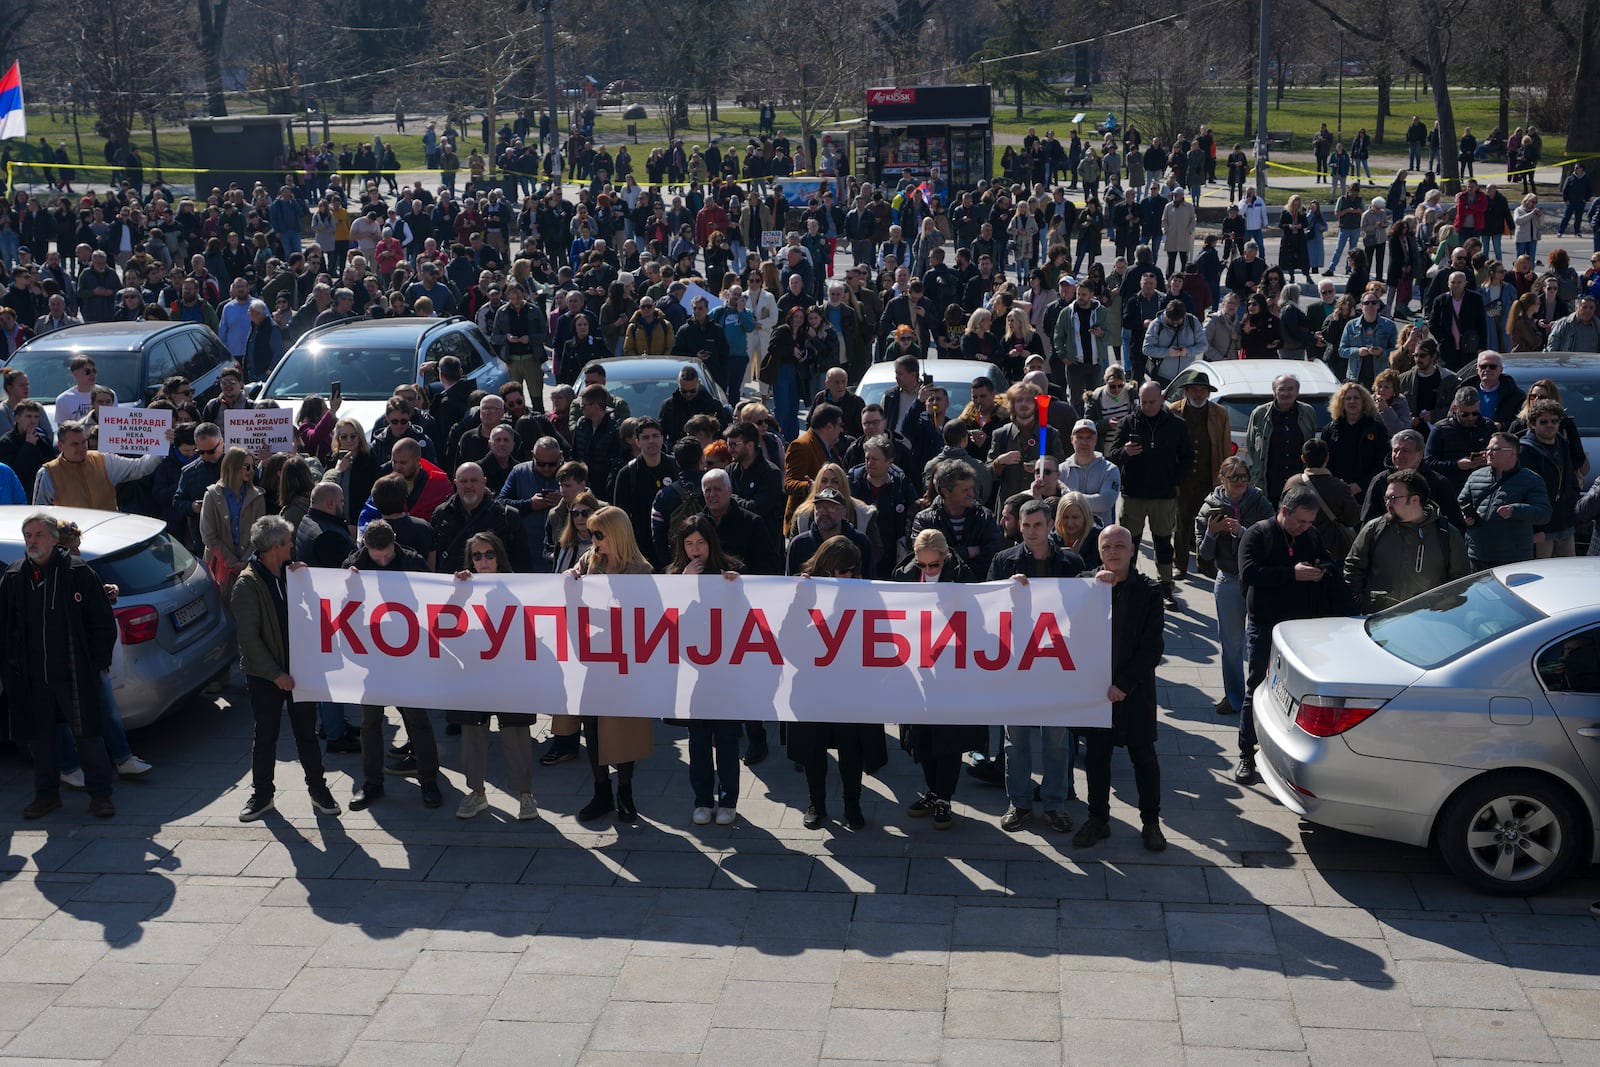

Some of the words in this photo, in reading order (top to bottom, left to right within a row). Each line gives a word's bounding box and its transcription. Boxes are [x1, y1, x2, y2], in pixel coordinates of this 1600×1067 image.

[104, 417, 129, 425] НЕМА
[131, 418, 167, 427] ПРАВДЕ
[257, 417, 289, 425] PRAVDE
[109, 437, 134, 445] НЕМА
[136, 438, 161, 446] МИРА
[243, 437, 266, 445] BUDE
[320, 598, 784, 674] КОРУПЦИЈА
[809, 609, 1074, 670] УБИЈА
